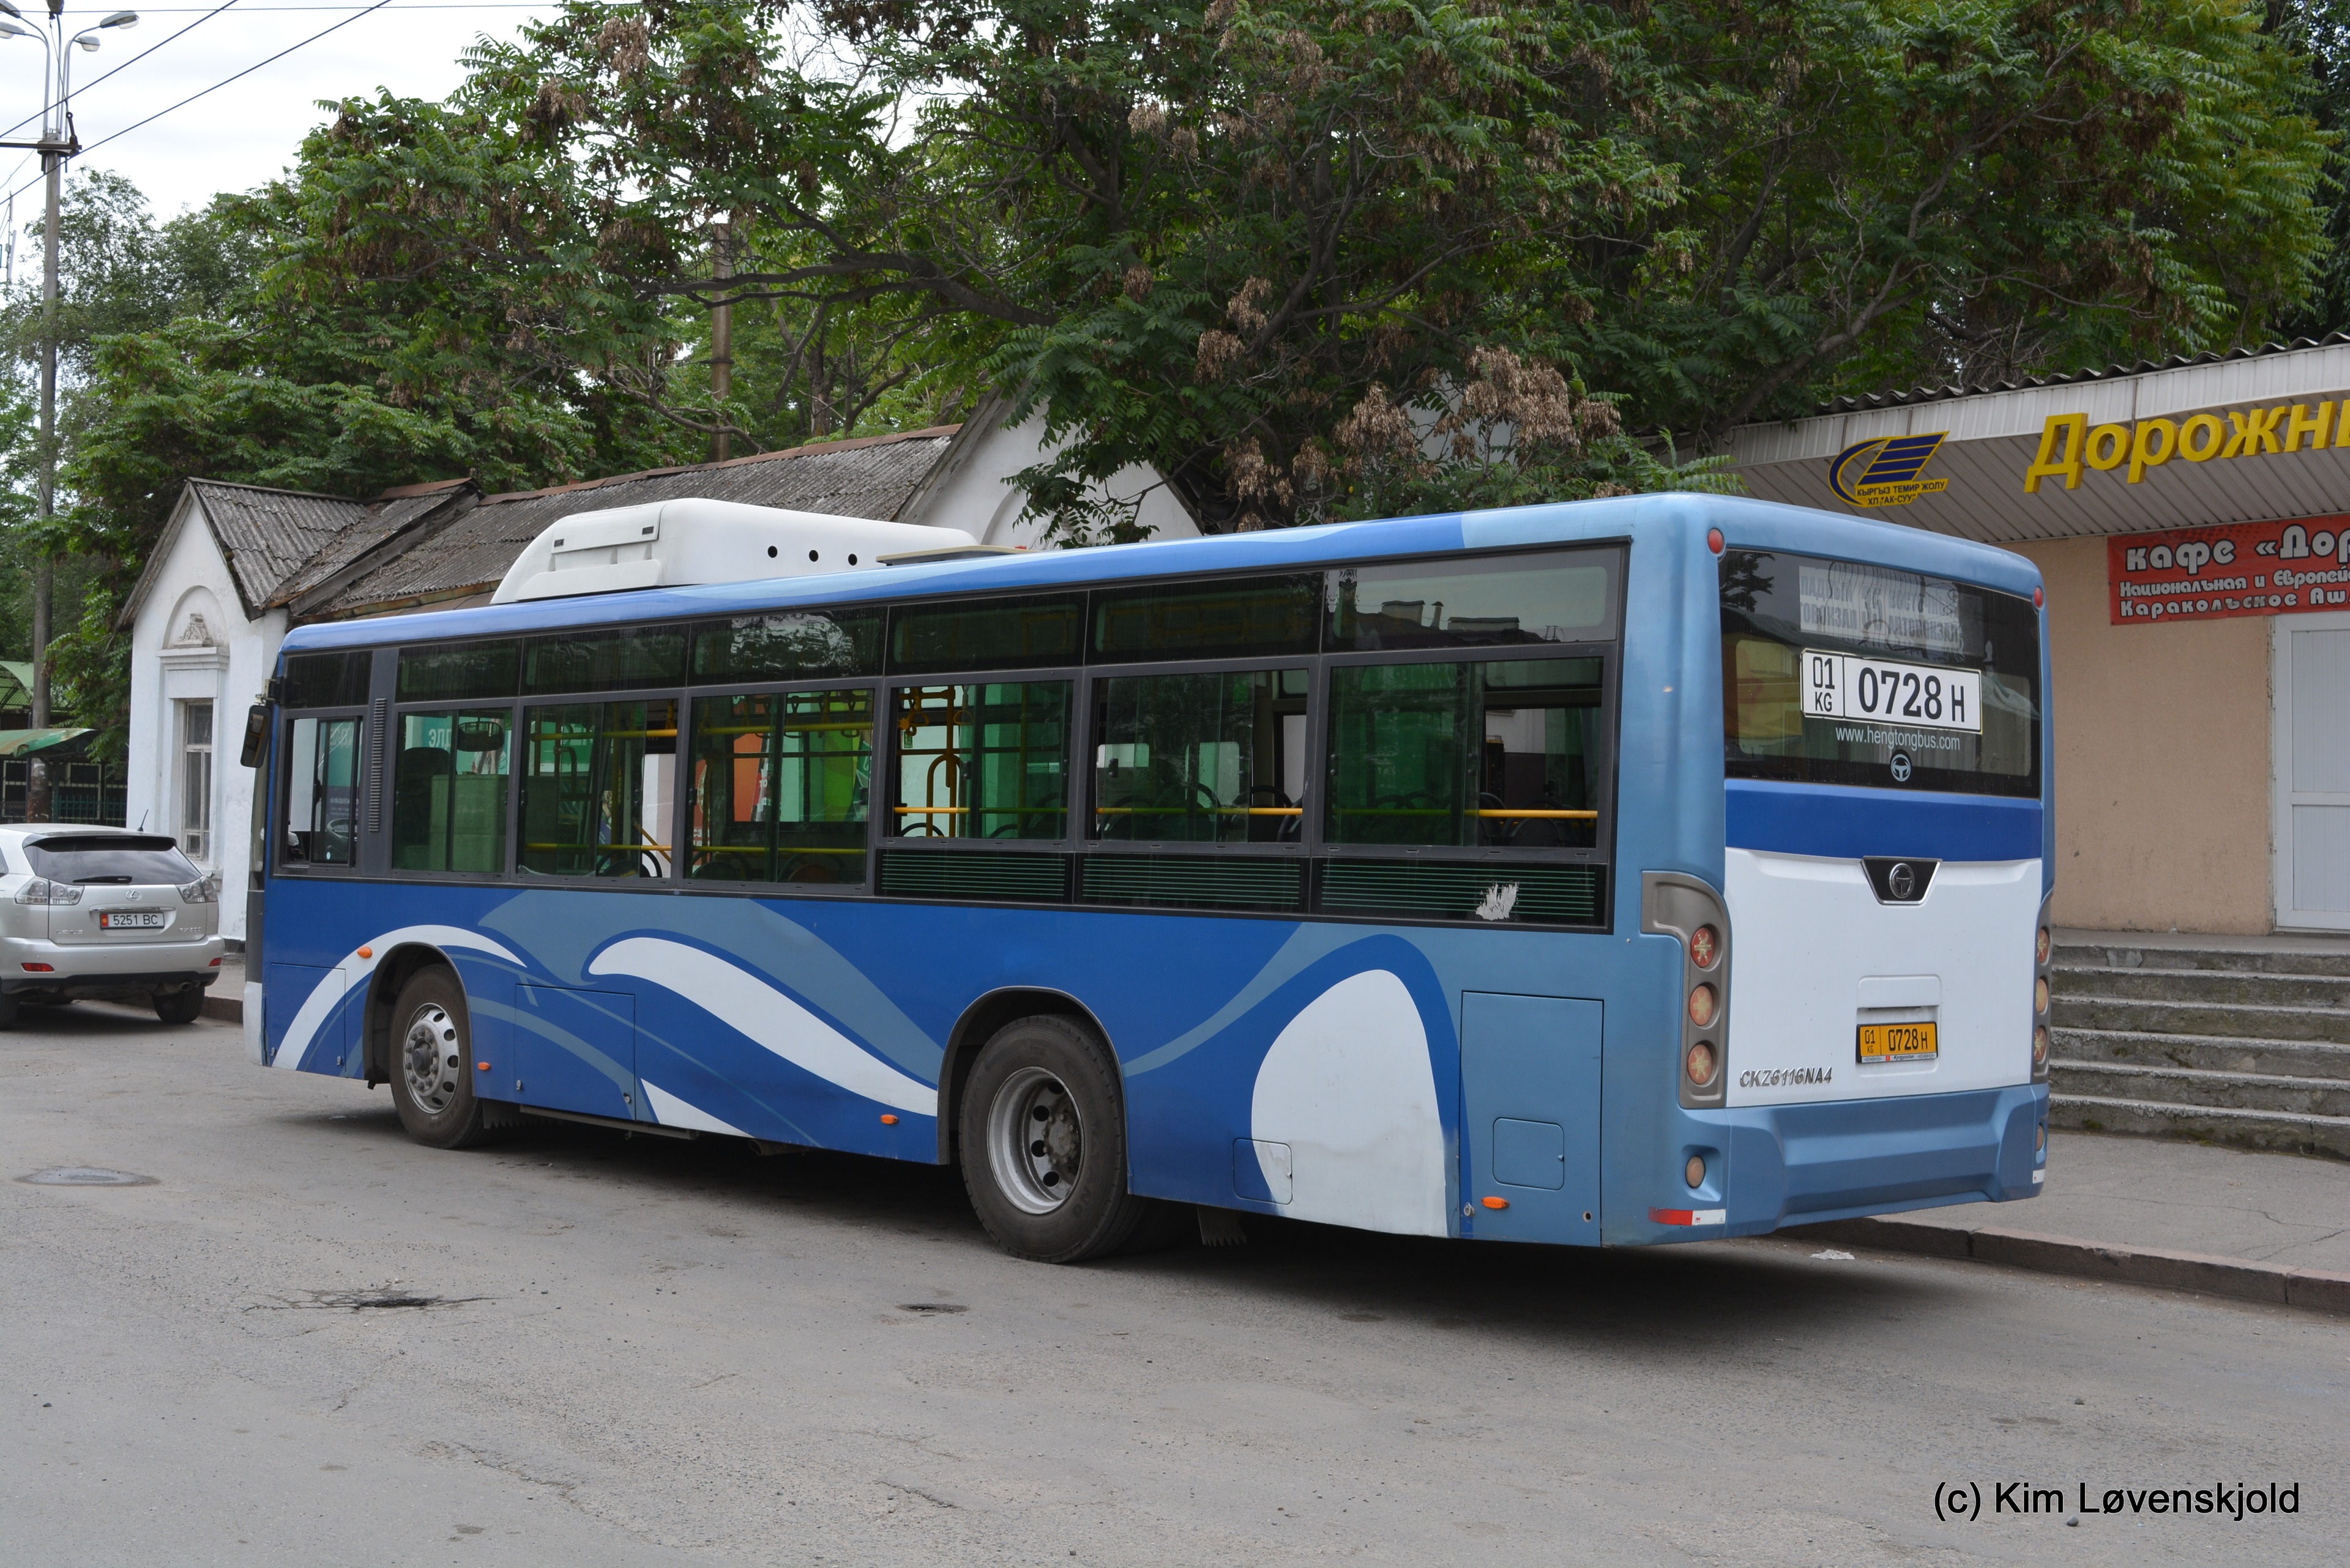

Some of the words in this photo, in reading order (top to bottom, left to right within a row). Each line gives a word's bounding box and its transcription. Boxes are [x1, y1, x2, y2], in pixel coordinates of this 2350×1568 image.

[1857, 487, 1890, 496] КЫРГЫЗ
[1893, 483, 1920, 493] ТЕМИР
[1922, 481, 1945, 491] ЖОЛУ
[1868, 497, 1879, 506] ХП
[2126, 539, 2236, 575] кафе
[2254, 575, 2266, 588] и
[2273, 564, 2350, 589] Европей
[2310, 587, 2350, 605] Аш
[1813, 656, 1835, 689] 01
[1815, 691, 1832, 712] KG
[1859, 667, 1942, 720] 0728
[1836, 725, 1960, 751] www.hengtongbus.com
[113, 914, 138, 925] 5251
[143, 914, 158, 925] BC
[1865, 1029, 1875, 1044] 01
[1888, 1028, 1919, 1051] 0728
[1740, 1067, 1832, 1088] CKZ6116NA4
